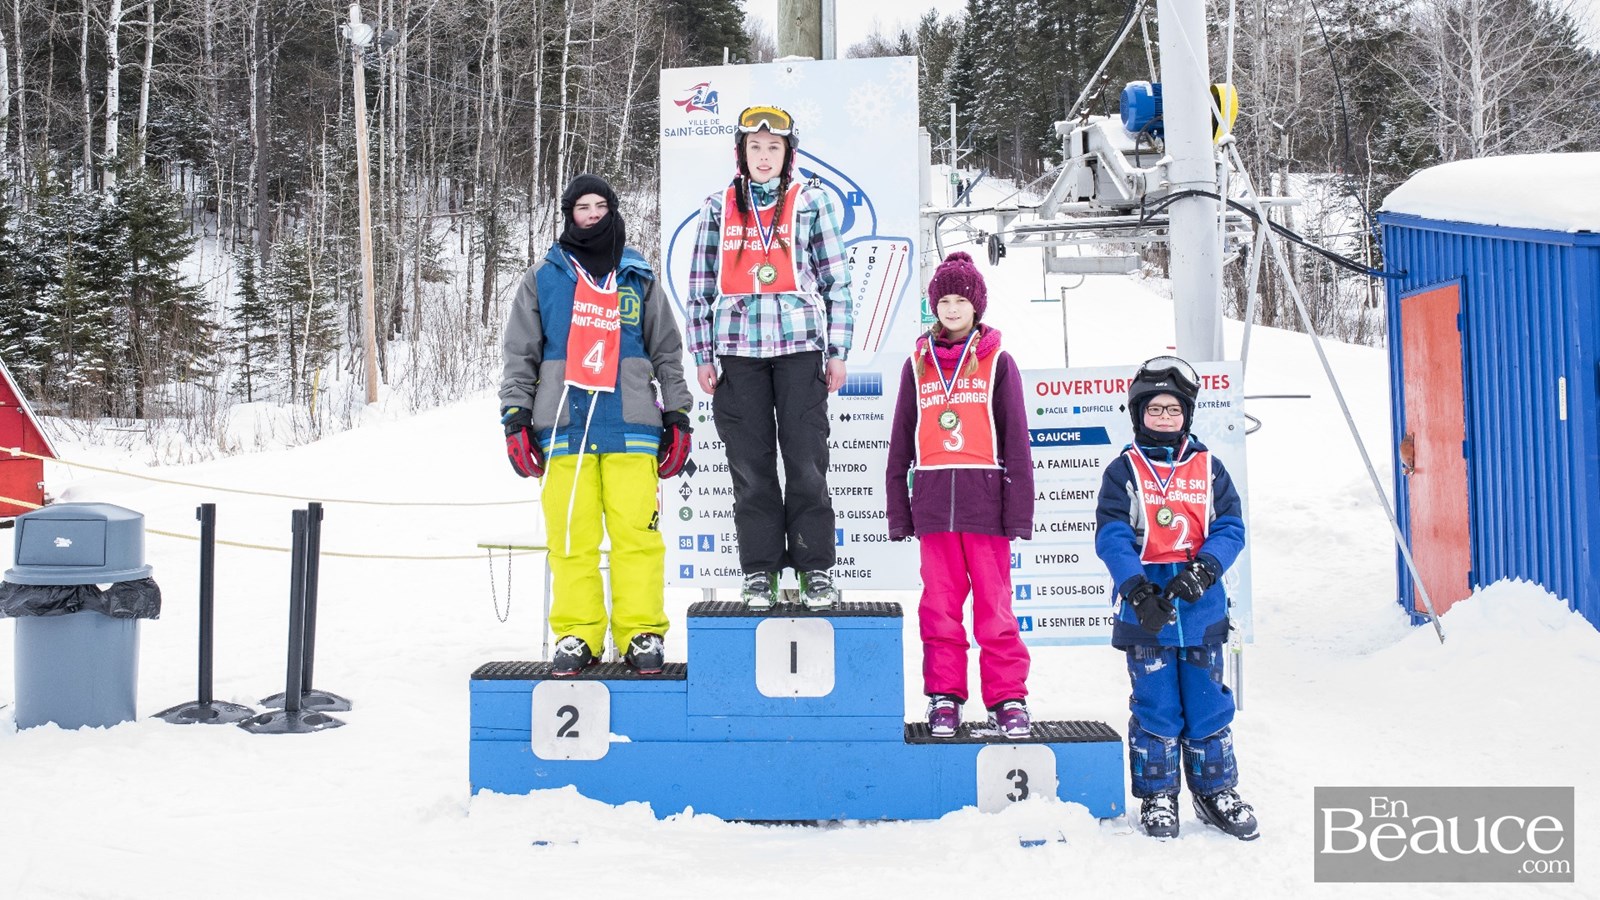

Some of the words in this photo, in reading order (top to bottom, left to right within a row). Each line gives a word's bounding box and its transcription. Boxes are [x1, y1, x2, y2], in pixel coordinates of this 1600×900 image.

[726, 224, 758, 238] CENRE
[871, 246, 878, 254] 7
[868, 256, 876, 264] B
[582, 340, 605, 374] 4
[957, 380, 969, 389] DE
[972, 378, 987, 389] SKI
[1197, 399, 1231, 409] EXTRÊME
[1045, 406, 1068, 414] FACILE
[1082, 405, 1114, 413] DIFFICILE
[852, 412, 884, 421] EXTRÊME
[943, 420, 965, 452] 3
[1037, 431, 1081, 442] GAUCHE
[698, 441, 709, 450] LA
[828, 440, 839, 449] LA
[698, 464, 709, 473] LA
[828, 463, 867, 473] L'HYDRO
[1048, 458, 1100, 469] FAMILIALE
[1176, 478, 1187, 490] DE
[1189, 479, 1206, 490] SKI
[680, 487, 691, 496] 2B
[699, 487, 710, 496] LA
[829, 487, 873, 496] L'EXPERTE
[1049, 489, 1095, 501] CLÉMENT
[1144, 490, 1207, 505] SAIN-GEORGES
[683, 510, 689, 518] 3
[699, 510, 710, 518] LA
[1034, 523, 1047, 533] LA
[1050, 520, 1096, 532] CLÉMENT
[1170, 513, 1193, 551] 2
[680, 538, 693, 548] 3B
[721, 533, 730, 541] LE
[851, 534, 860, 542] LE
[721, 545, 732, 554] DE
[1035, 554, 1079, 564] L'HYDRO
[683, 567, 690, 576] 4
[700, 568, 711, 576] LA
[829, 569, 872, 578] FIL-NEIGE
[1036, 586, 1047, 596] LE
[1050, 585, 1105, 596] SOUS-BOIS
[1038, 618, 1047, 627] LE
[1049, 617, 1086, 627] SENTIER
[1089, 617, 1100, 626] DE
[556, 704, 580, 738] 2
[1005, 768, 1029, 802] 3
